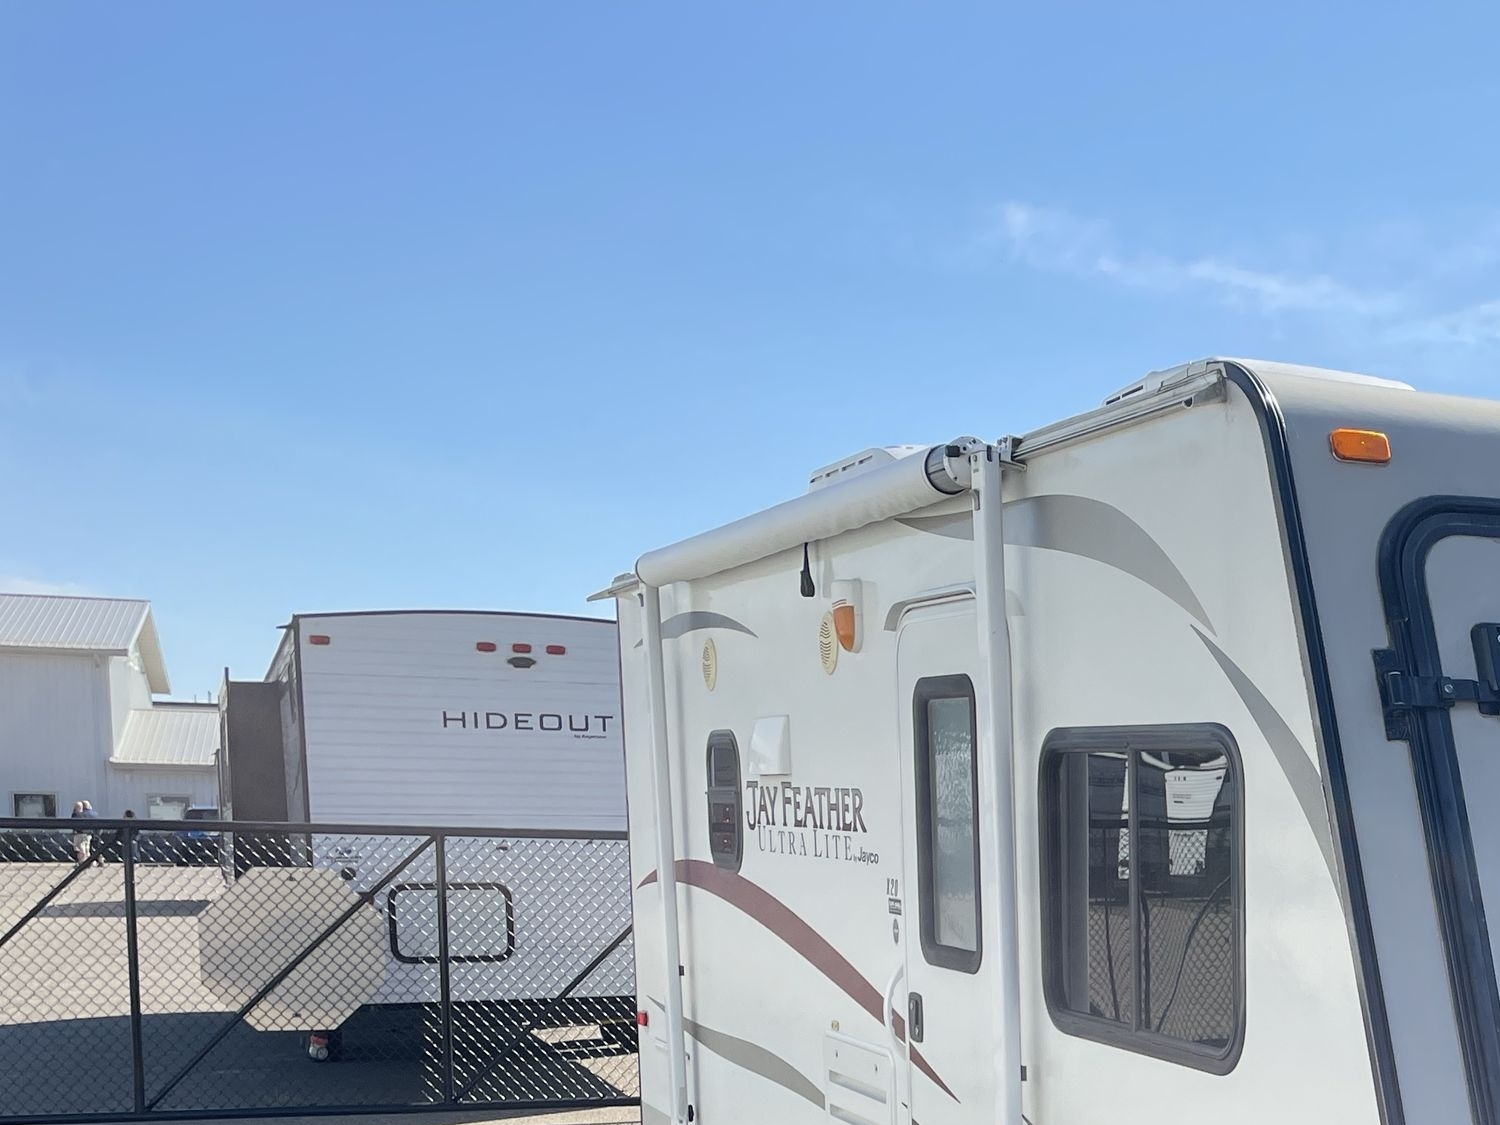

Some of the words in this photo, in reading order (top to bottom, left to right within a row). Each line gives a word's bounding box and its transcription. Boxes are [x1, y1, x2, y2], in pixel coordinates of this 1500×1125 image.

[443, 711, 613, 732] HIDEOUT
[746, 781, 777, 830] JAY
[781, 781, 867, 833] FEATHER
[757, 825, 808, 857] ULTRA
[812, 829, 853, 862] LITE
[857, 846, 880, 866] Jayco
